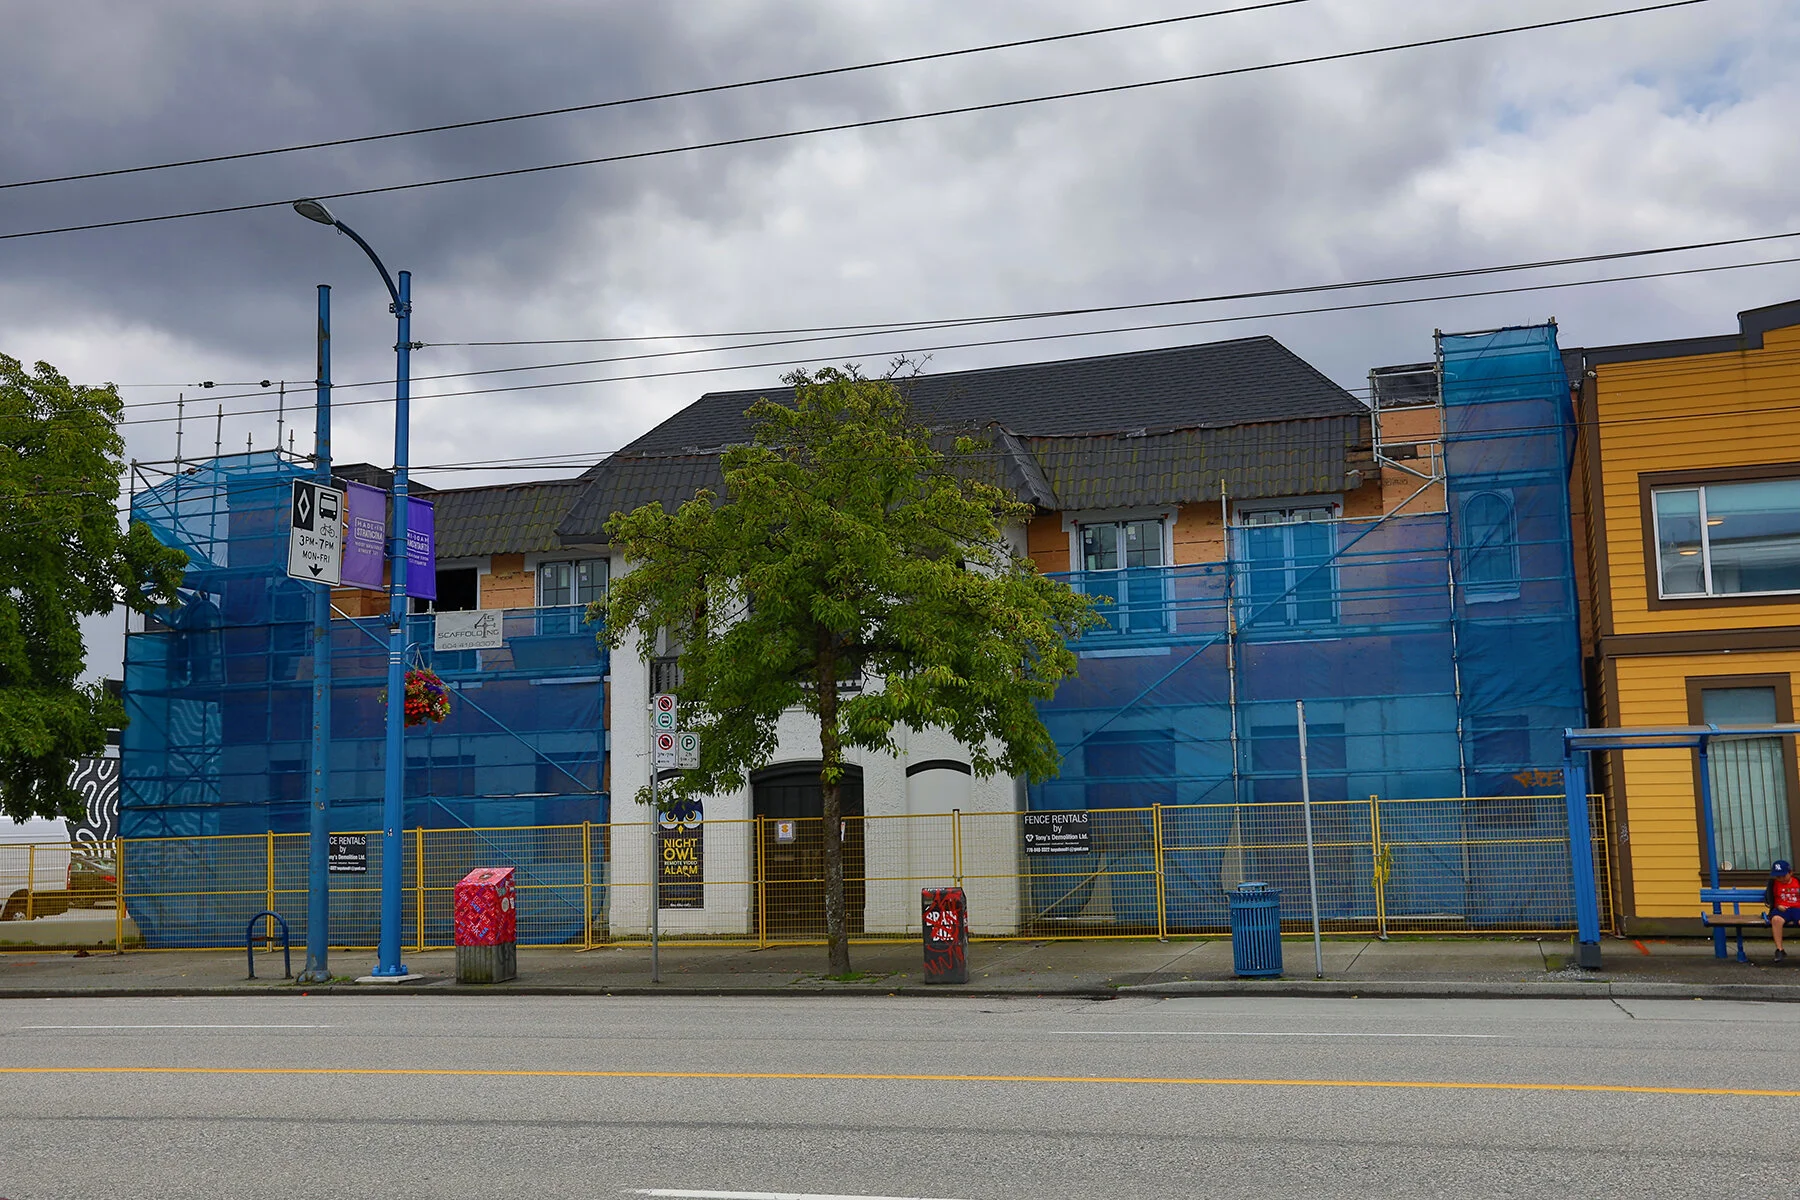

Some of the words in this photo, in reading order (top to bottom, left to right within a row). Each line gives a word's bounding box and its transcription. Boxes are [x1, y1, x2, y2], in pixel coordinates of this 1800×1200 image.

[302, 550, 330, 563] MON-FRI
[1024, 815, 1050, 824] FENCE
[1051, 813, 1088, 823] RENTALS
[1053, 824, 1063, 833] by
[338, 836, 366, 845] RENTALS
[664, 838, 698, 848] NIGHT
[339, 845, 347, 854] by
[663, 847, 698, 860] OWL
